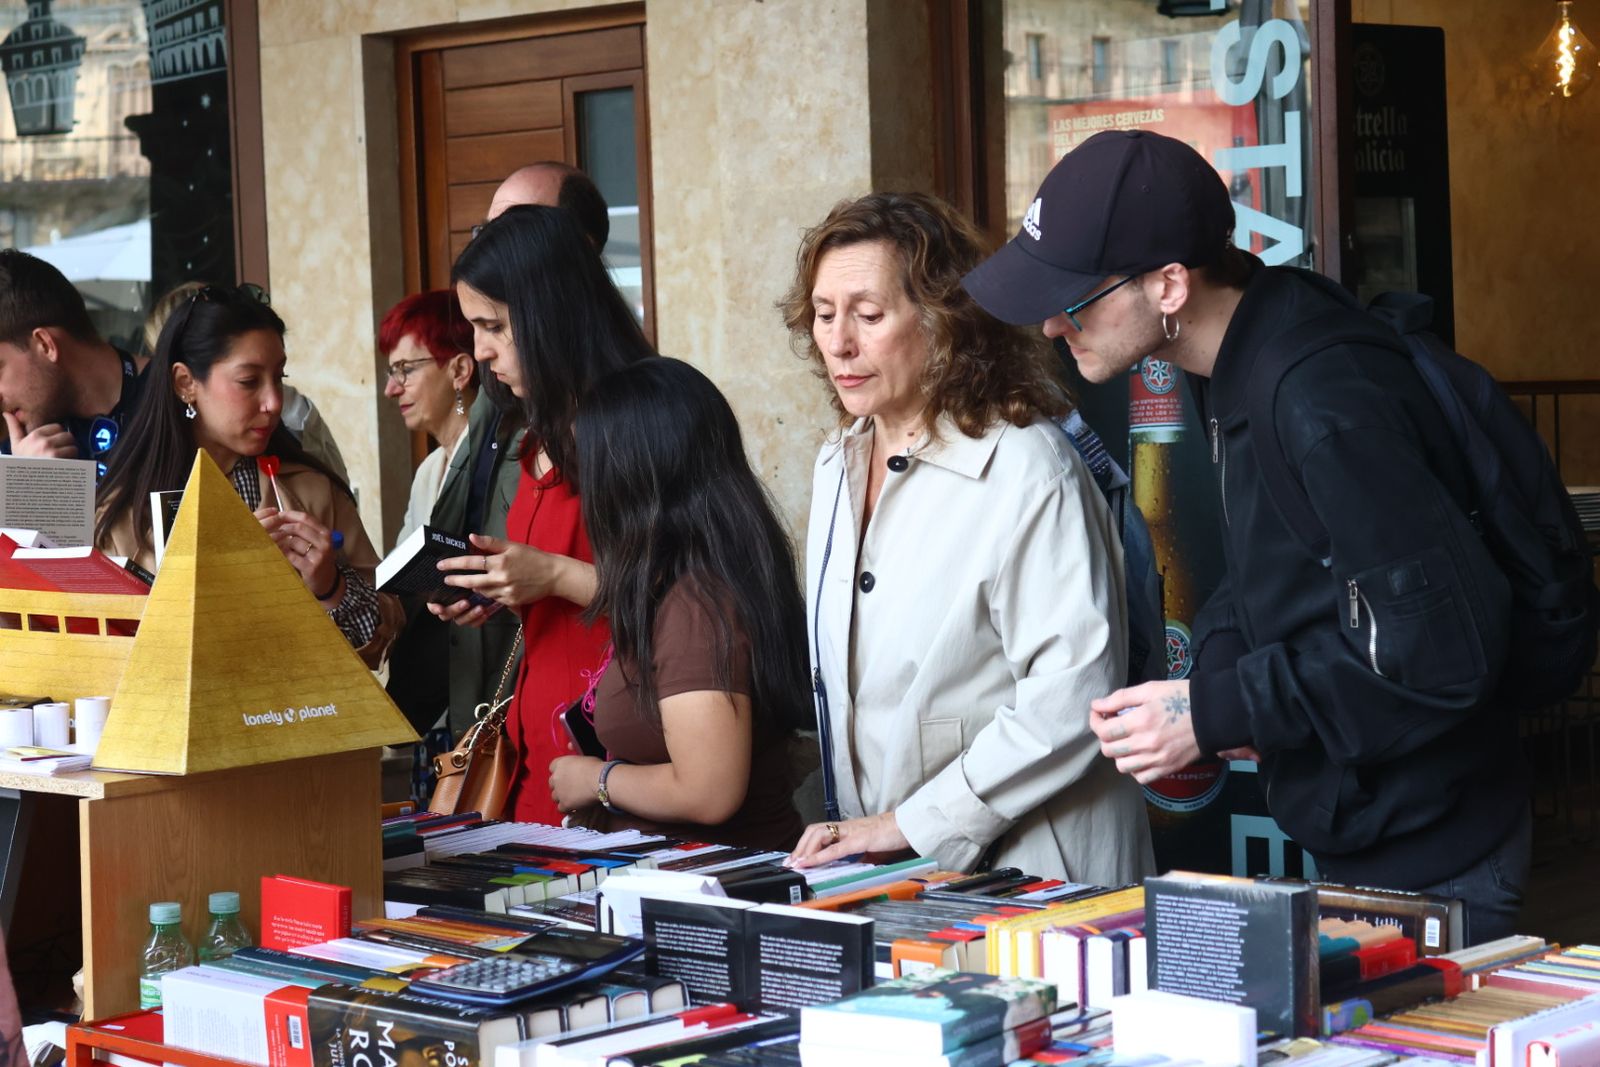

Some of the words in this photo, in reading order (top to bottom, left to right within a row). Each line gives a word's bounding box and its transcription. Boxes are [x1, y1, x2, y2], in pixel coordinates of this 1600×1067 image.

[1053, 118, 1072, 133] LAS
[1072, 113, 1115, 131] MEJORES
[1115, 108, 1165, 127] CERVEZAS
[1210, 0, 1304, 266] STA
[1353, 104, 1408, 137] trella
[1354, 138, 1406, 173] alicia
[445, 536, 466, 550] DICKER
[242, 709, 284, 726] lonely
[298, 702, 338, 722] planet
